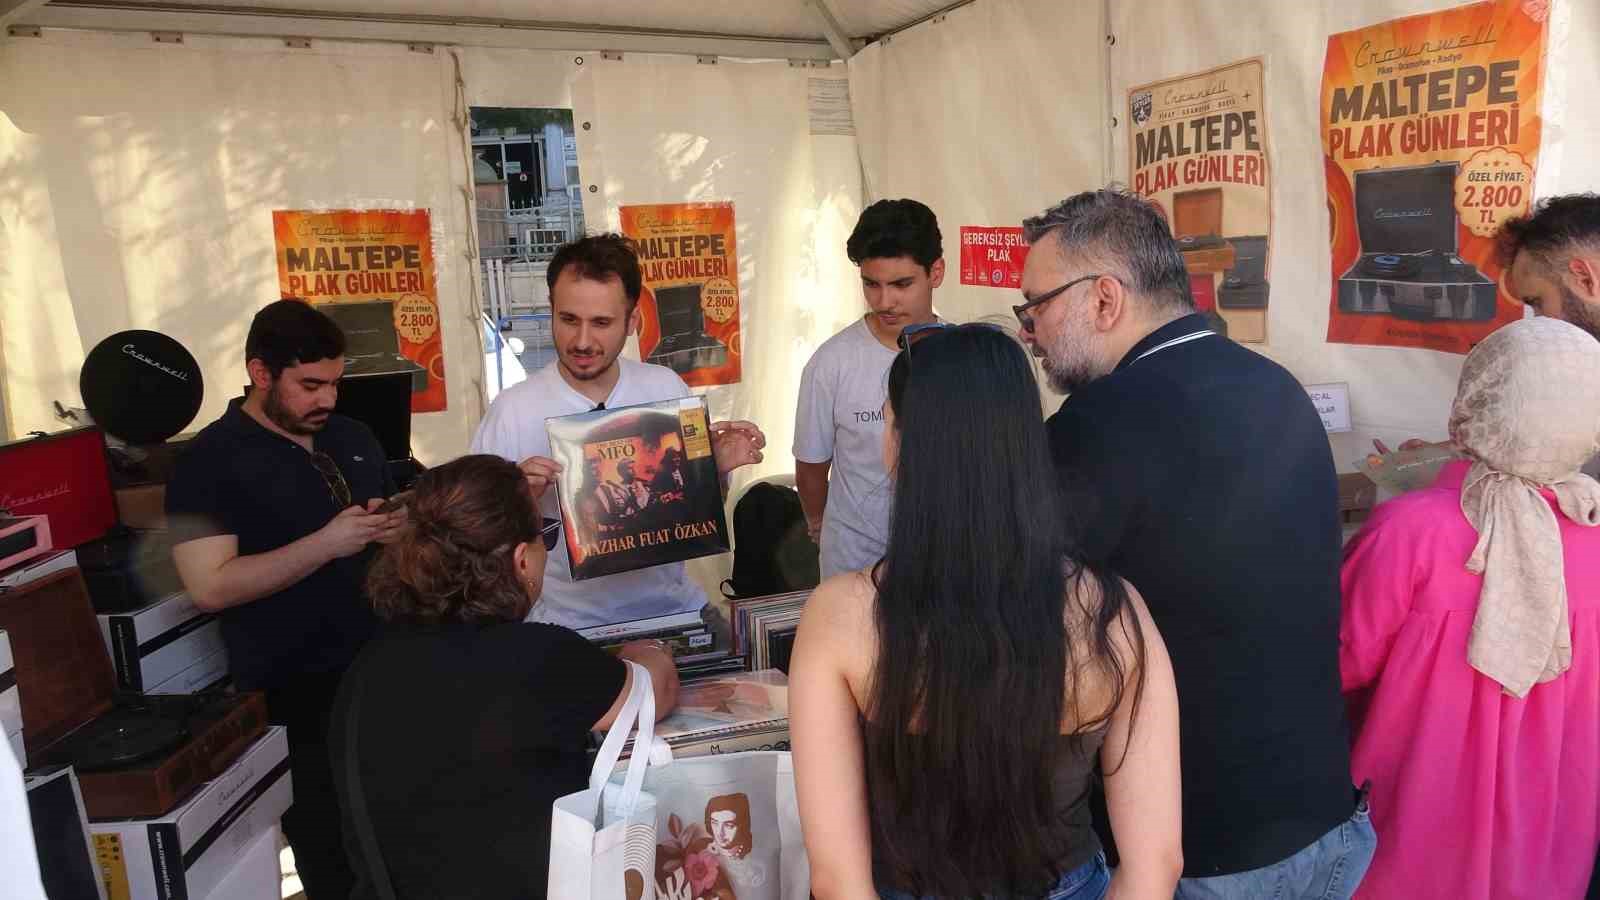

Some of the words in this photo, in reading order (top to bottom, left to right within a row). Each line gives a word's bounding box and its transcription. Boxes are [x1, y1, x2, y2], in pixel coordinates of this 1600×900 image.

[1330, 60, 1520, 124] MALTEPE
[1135, 110, 1260, 170] MALTEPE
[1328, 122, 1394, 160] PLAK
[1400, 103, 1520, 155] GÜNLERİ
[1135, 161, 1178, 196] PLAK
[1184, 152, 1264, 187] GÜNLERİ
[1468, 170, 1493, 182] ÖZEL
[1462, 185, 1522, 207] 2.800
[1479, 210, 1496, 223] TL
[963, 230, 1003, 246] GEREKSİZ
[286, 244, 421, 272] MALTEPE
[987, 248, 1011, 262] PLAK
[665, 256, 728, 280] GÜNLERİ
[288, 273, 342, 297] PLAK
[346, 268, 425, 295] GÜNLERİ
[400, 313, 433, 327] 2.800
[412, 327, 422, 336] TL
[639, 528, 670, 547] FUAT
[674, 519, 718, 539] ÖZKAN
